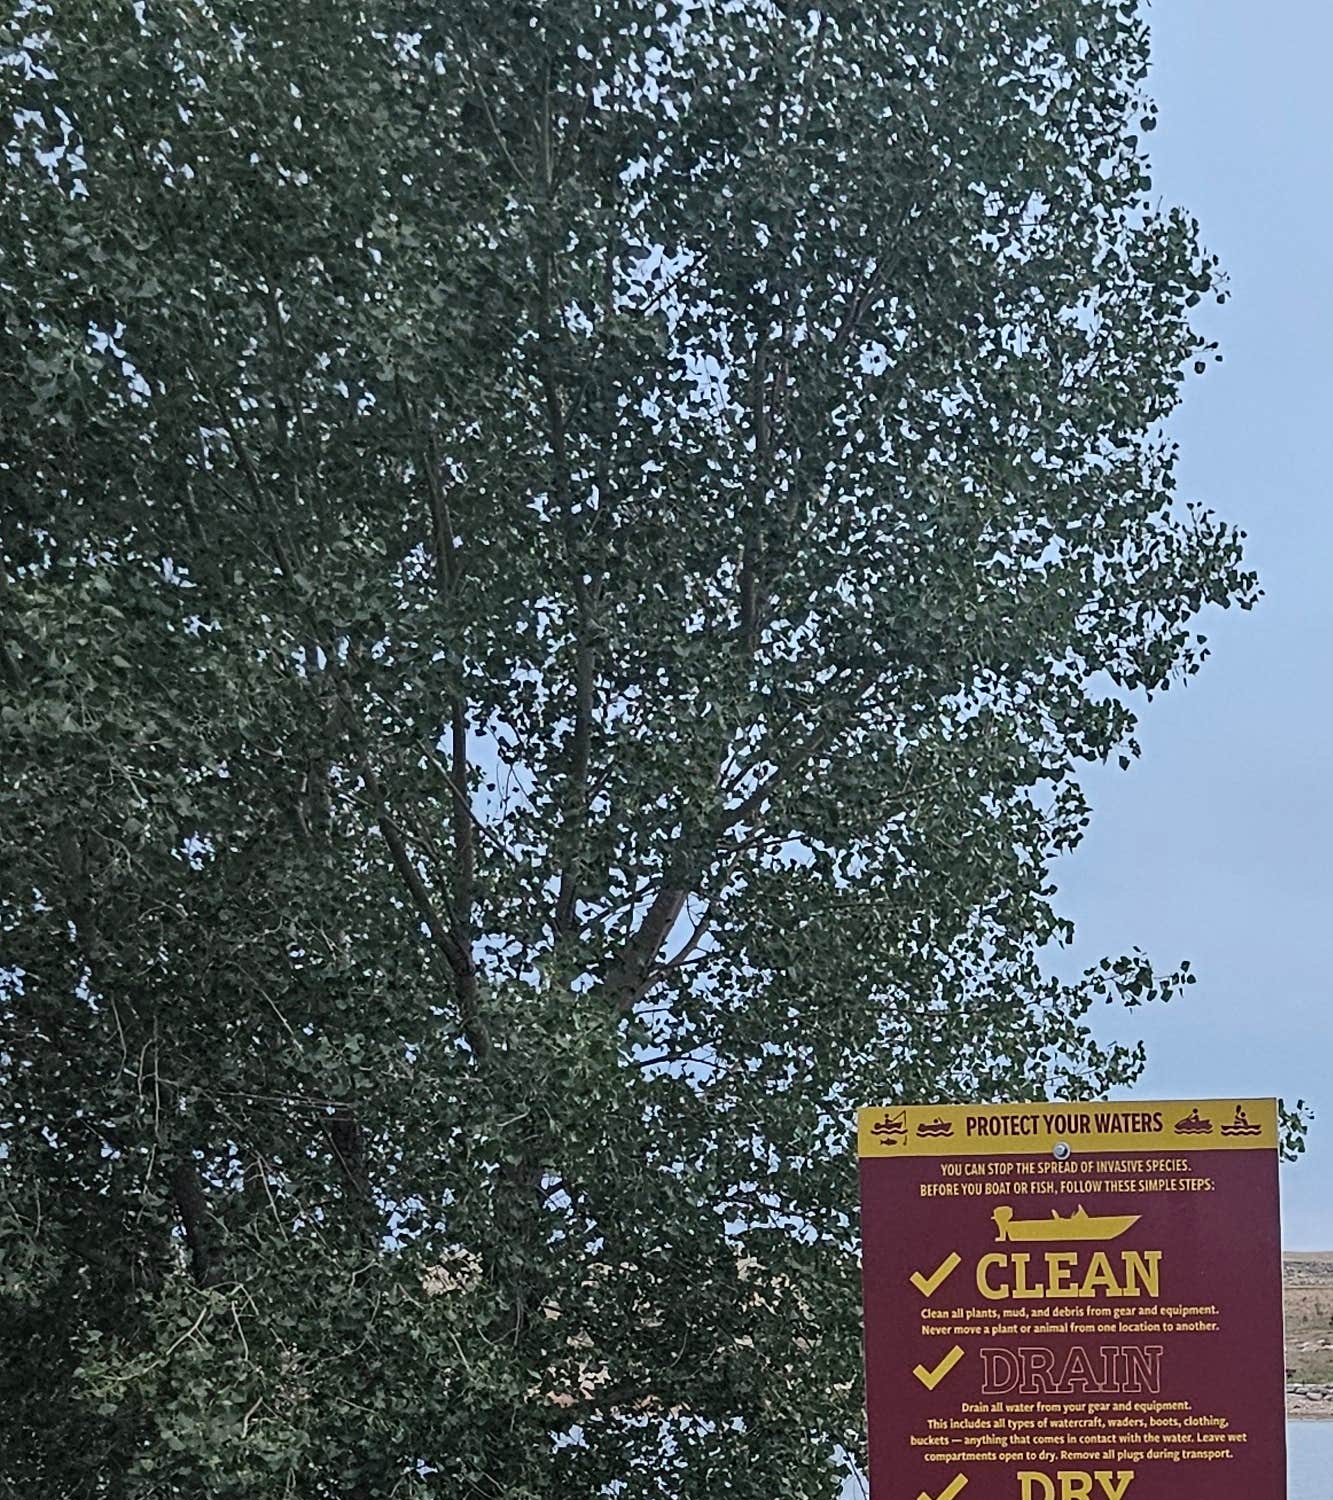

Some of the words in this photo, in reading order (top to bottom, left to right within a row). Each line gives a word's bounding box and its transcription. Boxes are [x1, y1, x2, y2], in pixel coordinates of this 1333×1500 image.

[966, 1115, 1039, 1136] PROTECT
[1042, 1114, 1090, 1134] YOUR
[1094, 1112, 1162, 1133] WATERS
[941, 1164, 961, 1176] YOU
[965, 1163, 984, 1175] CAN
[987, 1162, 1013, 1174] STOP
[1016, 1162, 1034, 1173] THE
[1037, 1161, 1077, 1173] SPREAD
[1080, 1161, 1092, 1172] OF
[1096, 1160, 1142, 1172] INVASIVE
[1146, 1159, 1191, 1171] SPECIES.
[920, 1183, 958, 1195] BEFORE
[961, 1183, 981, 1195] YOU
[985, 1182, 1010, 1194] BOAT
[1014, 1182, 1027, 1193] OR
[1031, 1181, 1057, 1194] FISH,
[1061, 1180, 1101, 1192] FOLLOW
[1104, 1180, 1135, 1192] THESE
[1138, 1179, 1176, 1191] SIMPLE
[1179, 1178, 1214, 1190] STEPS:
[976, 1251, 1161, 1298] CLEAN
[921, 1308, 948, 1318] Clean
[951, 1308, 963, 1317] all
[966, 1307, 1000, 1320] plants,
[1003, 1307, 1028, 1318] mud,
[1031, 1307, 1049, 1316] and
[1052, 1306, 1083, 1316] debris
[1086, 1305, 1111, 1315] from
[1113, 1307, 1135, 1318] gear
[1138, 1305, 1157, 1314] and
[1160, 1304, 1218, 1317] equipment.
[922, 1325, 951, 1334] Never
[992, 1323, 1017, 1335] plant
[1034, 1322, 1067, 1332] animal
[1070, 1322, 1094, 1332] from
[1119, 1321, 1160, 1331] location
[1162, 1323, 1173, 1331] to
[1176, 1320, 1219, 1330] another.
[980, 1345, 1163, 1394] DRAIN
[962, 1401, 988, 1411] Drain
[990, 1402, 1002, 1411] all
[1005, 1403, 1034, 1411] water
[1036, 1401, 1060, 1411] from
[1063, 1403, 1085, 1413] your
[1088, 1403, 1110, 1413] gear
[1112, 1400, 1131, 1410] and
[1134, 1400, 1191, 1412] equipment.
[910, 1435, 948, 1444] buckets
[964, 1433, 1007, 1447] anything
[1009, 1434, 1030, 1443] that
[1067, 1433, 1076, 1442] in
[1079, 1434, 1116, 1443] contact
[1119, 1432, 1140, 1442] with
[1143, 1432, 1159, 1442] the
[1162, 1433, 1193, 1442] water.
[1197, 1432, 1225, 1441] Leave
[1228, 1433, 1246, 1441] wet
